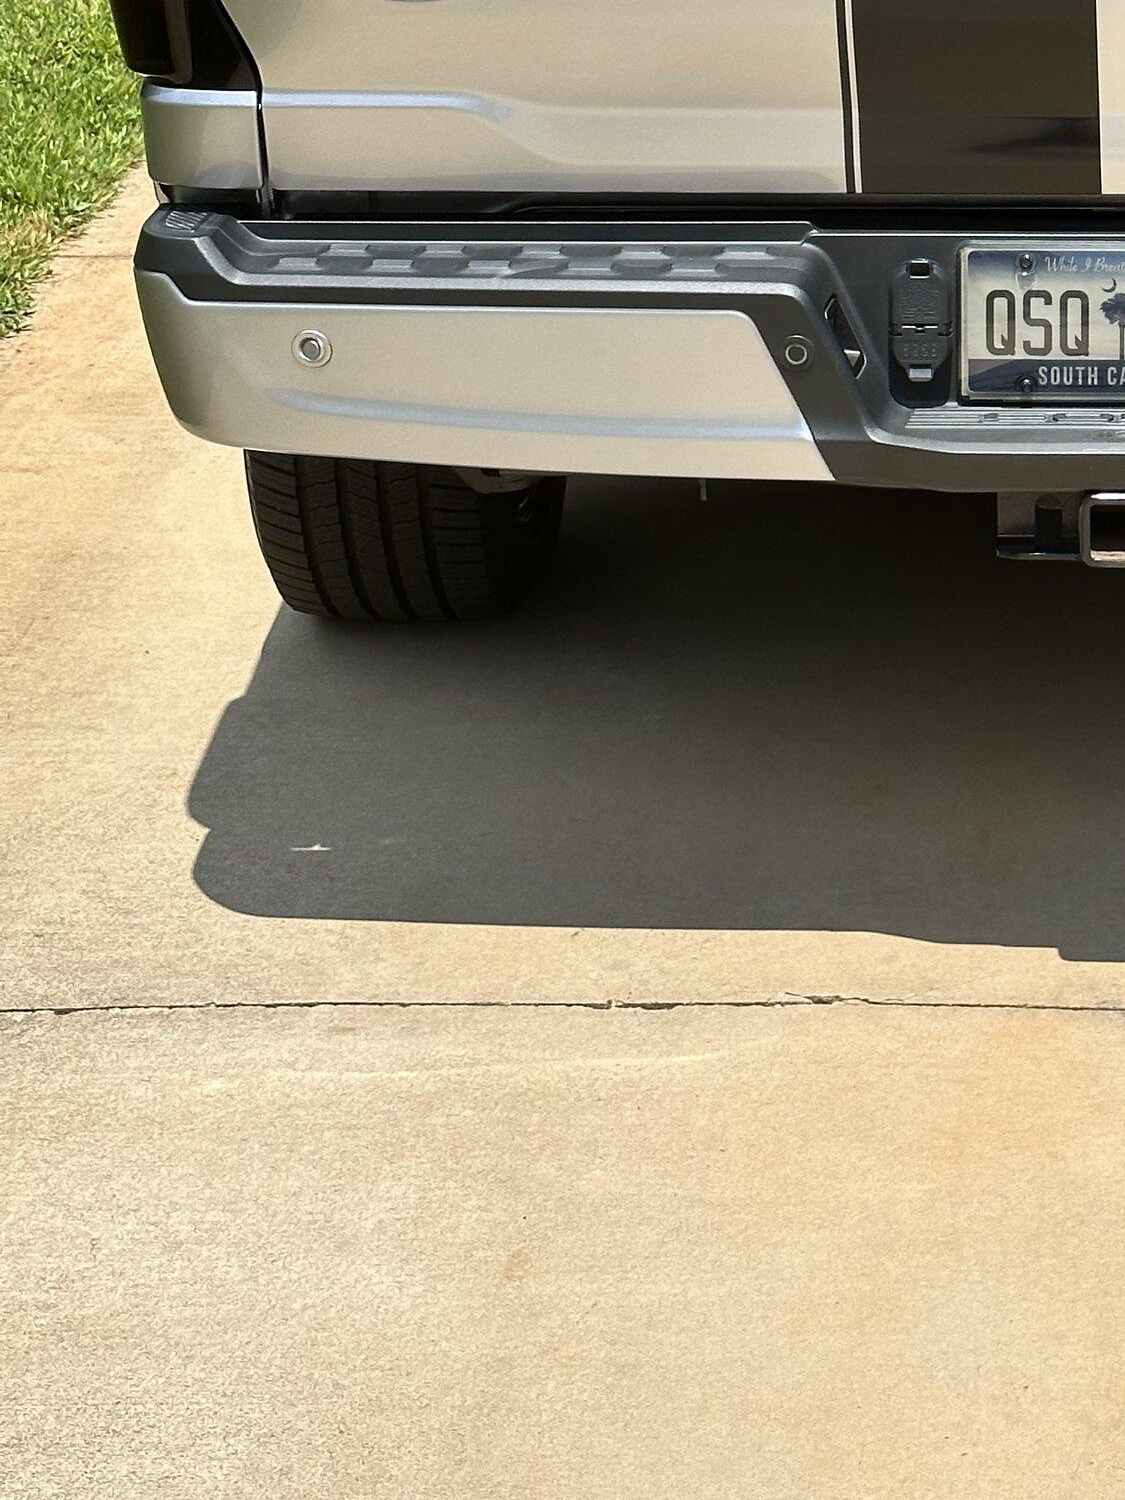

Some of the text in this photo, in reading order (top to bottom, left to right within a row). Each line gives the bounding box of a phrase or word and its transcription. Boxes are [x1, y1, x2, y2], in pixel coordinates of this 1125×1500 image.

[1045, 257, 1078, 272] While
[1082, 258, 1092, 272] I
[986, 290, 1090, 357] QSQ
[1038, 366, 1098, 386] SOUTH
